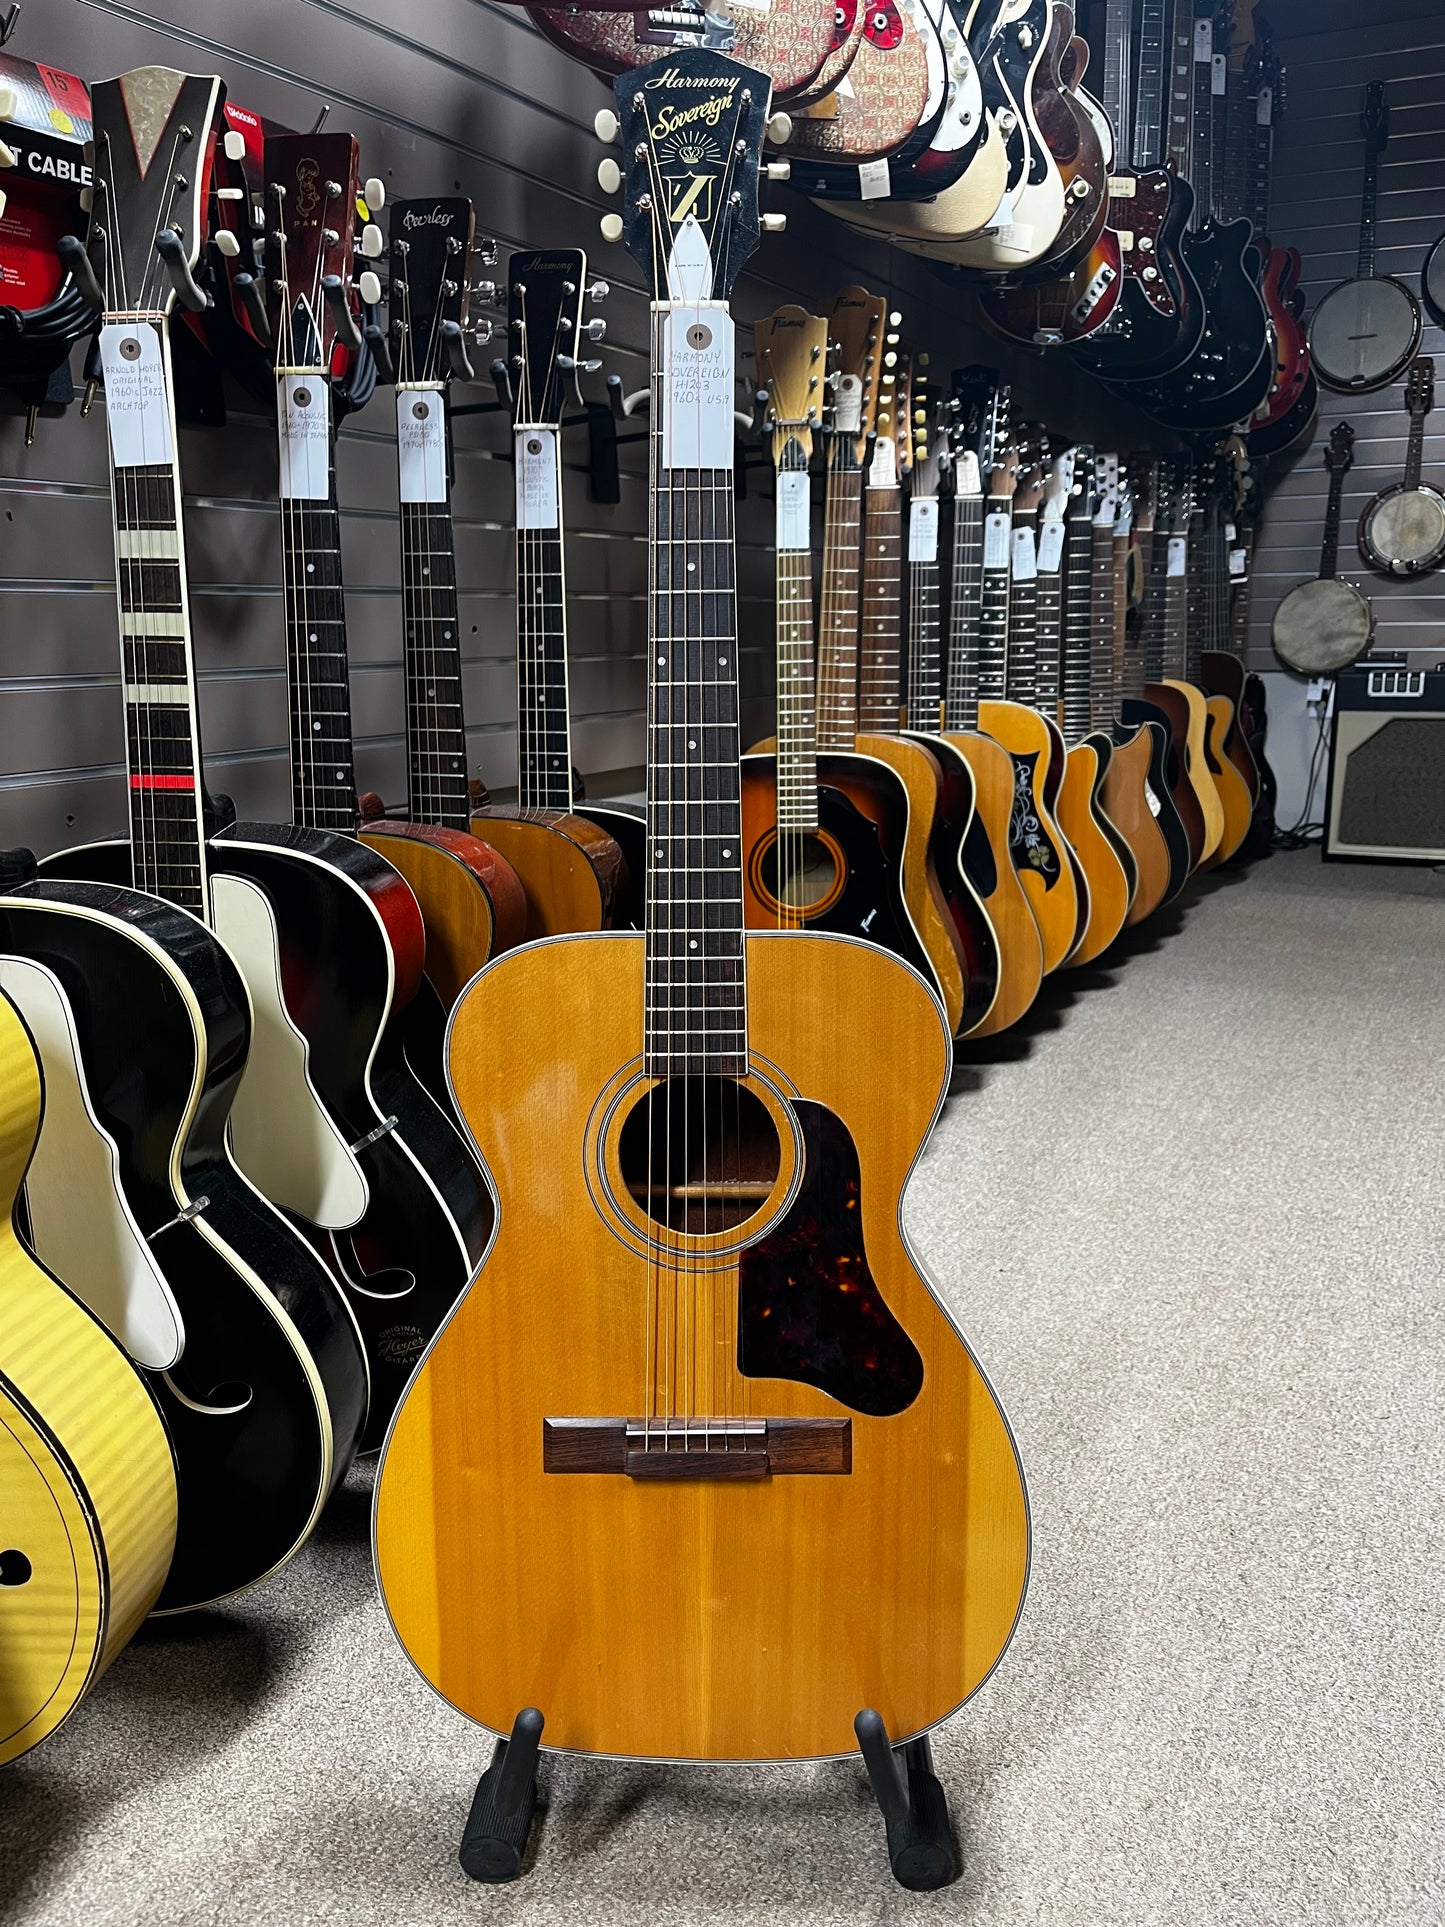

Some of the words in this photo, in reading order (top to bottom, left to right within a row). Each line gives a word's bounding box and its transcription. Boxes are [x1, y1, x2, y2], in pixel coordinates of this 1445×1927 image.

[644, 68, 741, 94] Harmony
[651, 95, 733, 140] Sovereign
[27, 151, 93, 186] CABLE
[294, 219, 318, 227] PAN
[402, 205, 455, 231] Peerless
[522, 256, 574, 273] Harmony
[104, 365, 136, 375] ARNOLD
[379, 1325, 421, 1338] ORIGINAL
